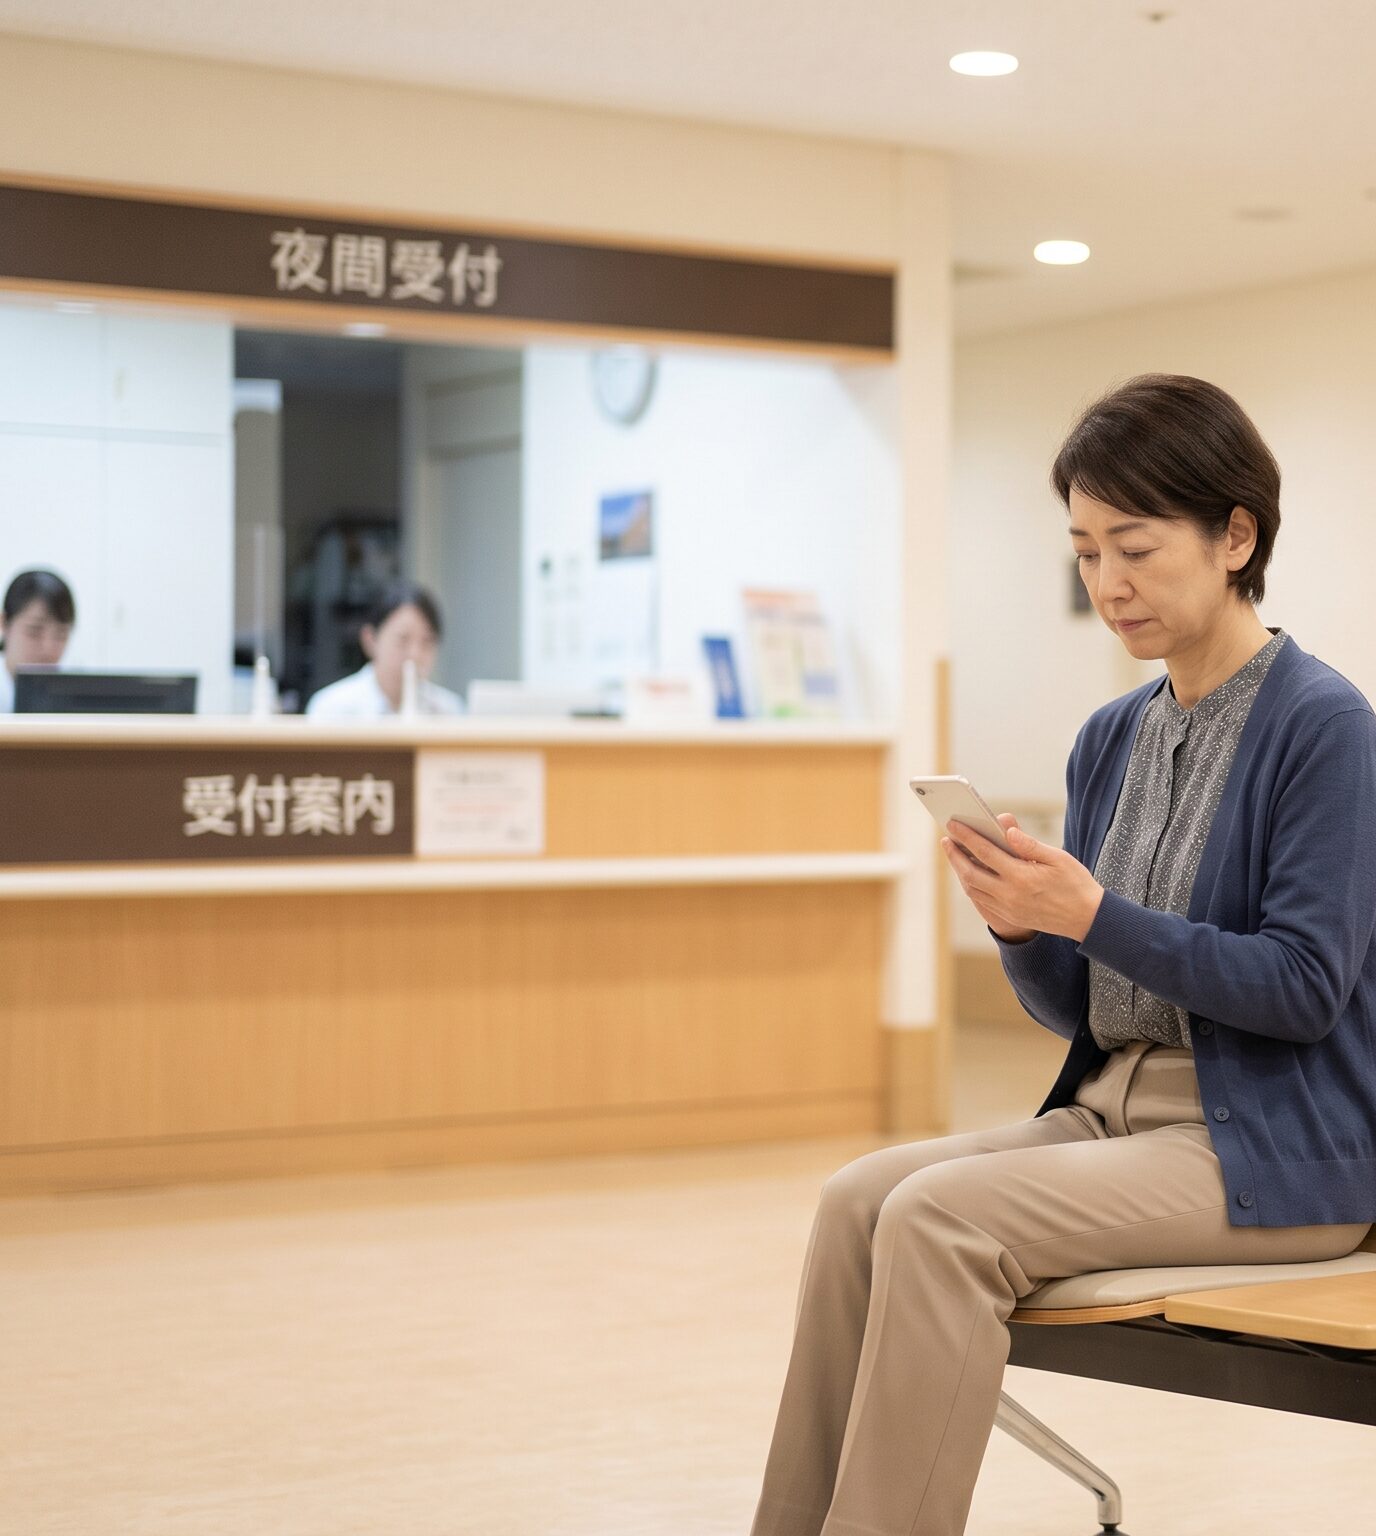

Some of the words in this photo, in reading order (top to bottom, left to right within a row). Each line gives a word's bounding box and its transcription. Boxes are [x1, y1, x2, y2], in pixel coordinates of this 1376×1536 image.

[271, 228, 502, 307] 夜間受付
[183, 773, 395, 837] 受付案内
